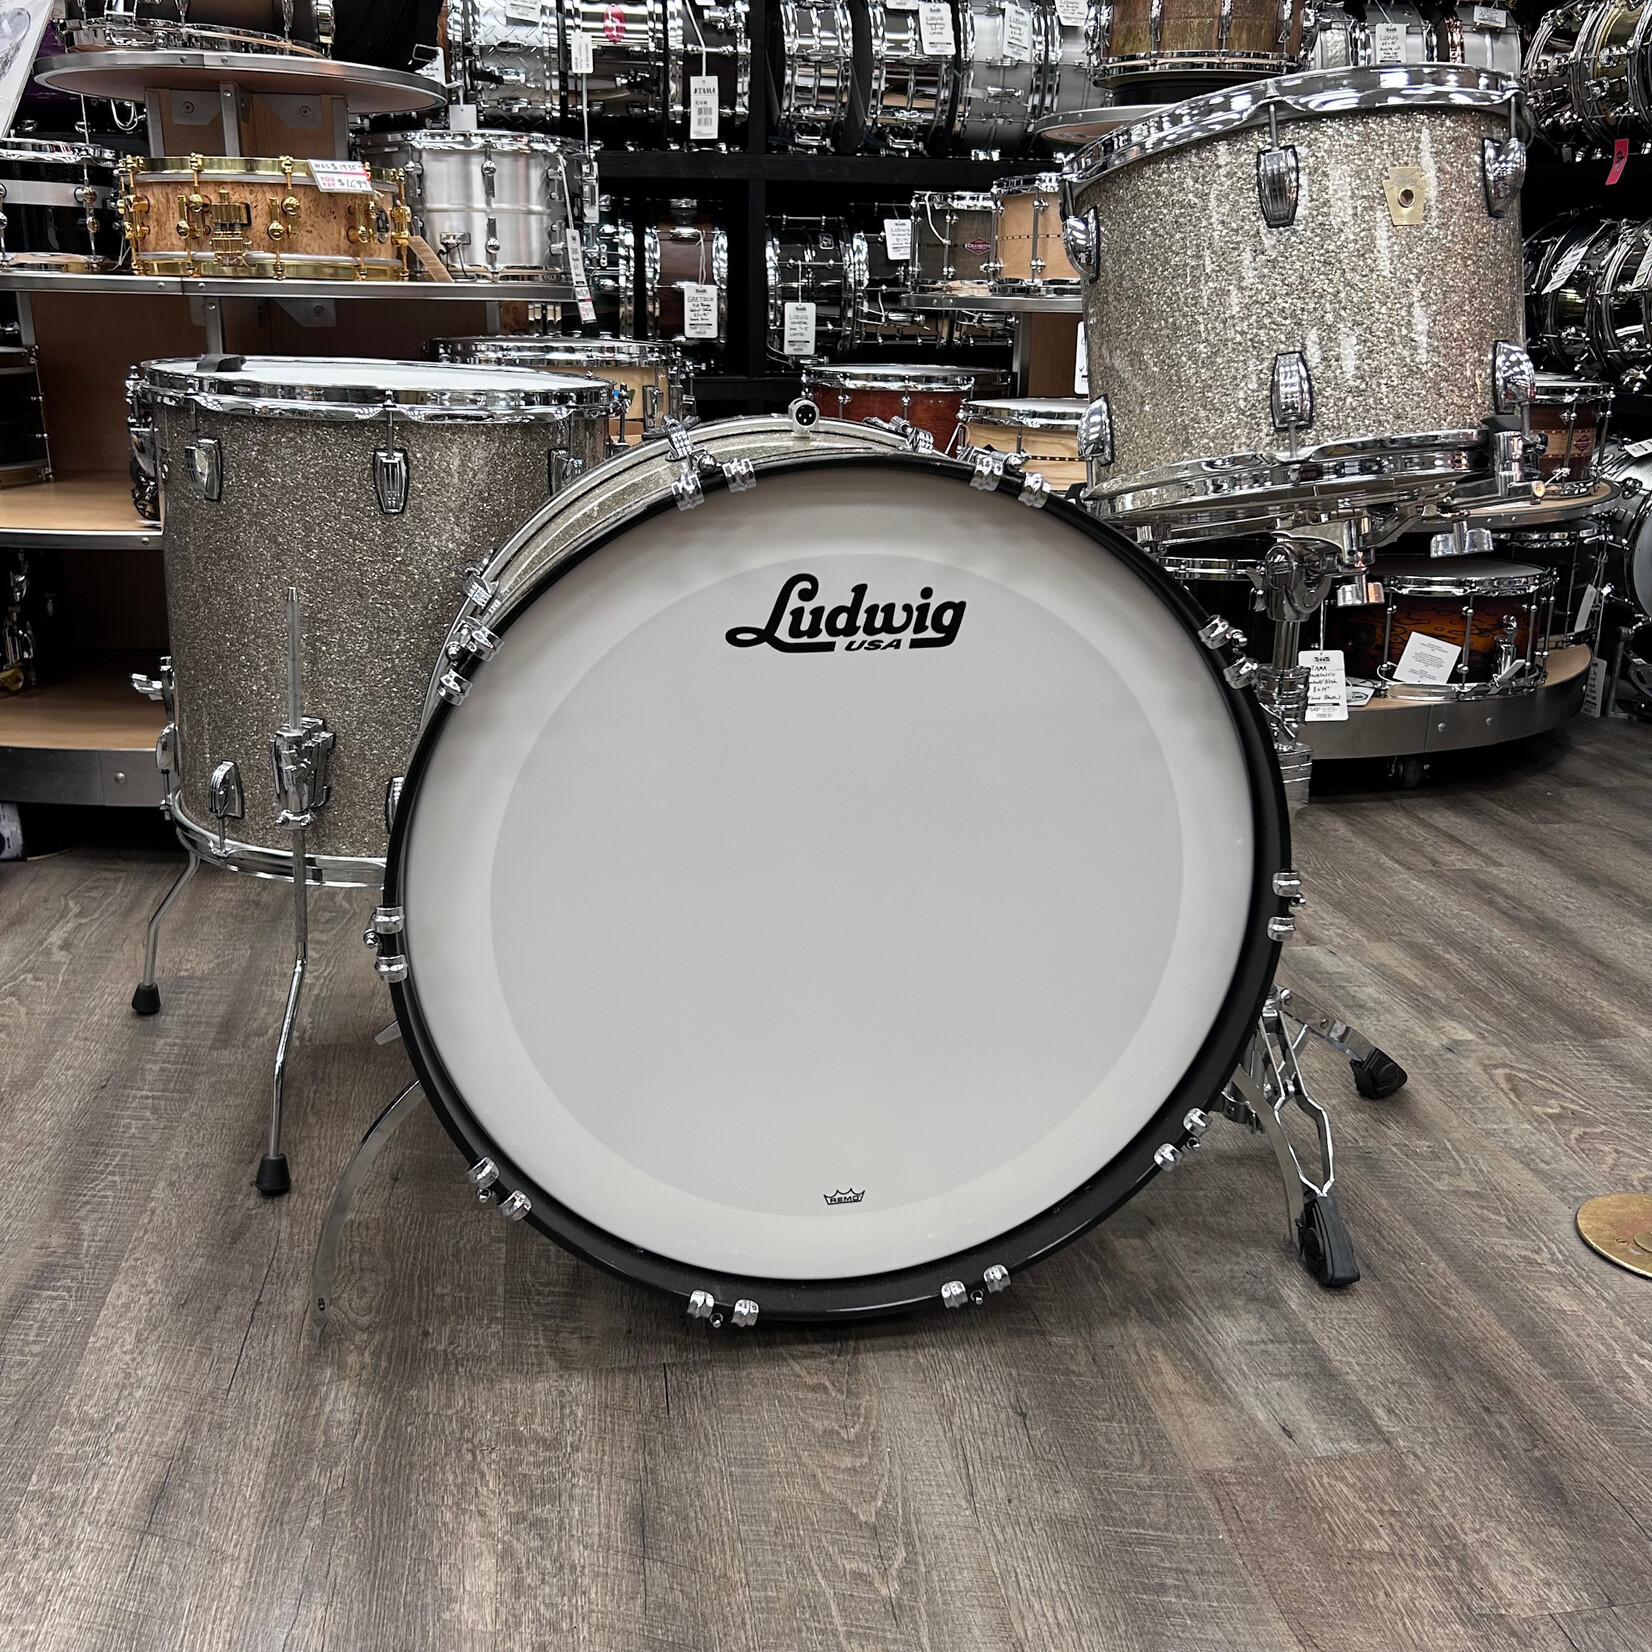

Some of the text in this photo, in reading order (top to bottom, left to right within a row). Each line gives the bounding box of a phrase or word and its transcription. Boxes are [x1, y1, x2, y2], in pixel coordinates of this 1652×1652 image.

[725, 573, 967, 654] Ludwig
[844, 638, 902, 652] USA
[829, 1195, 860, 1204] REMO
